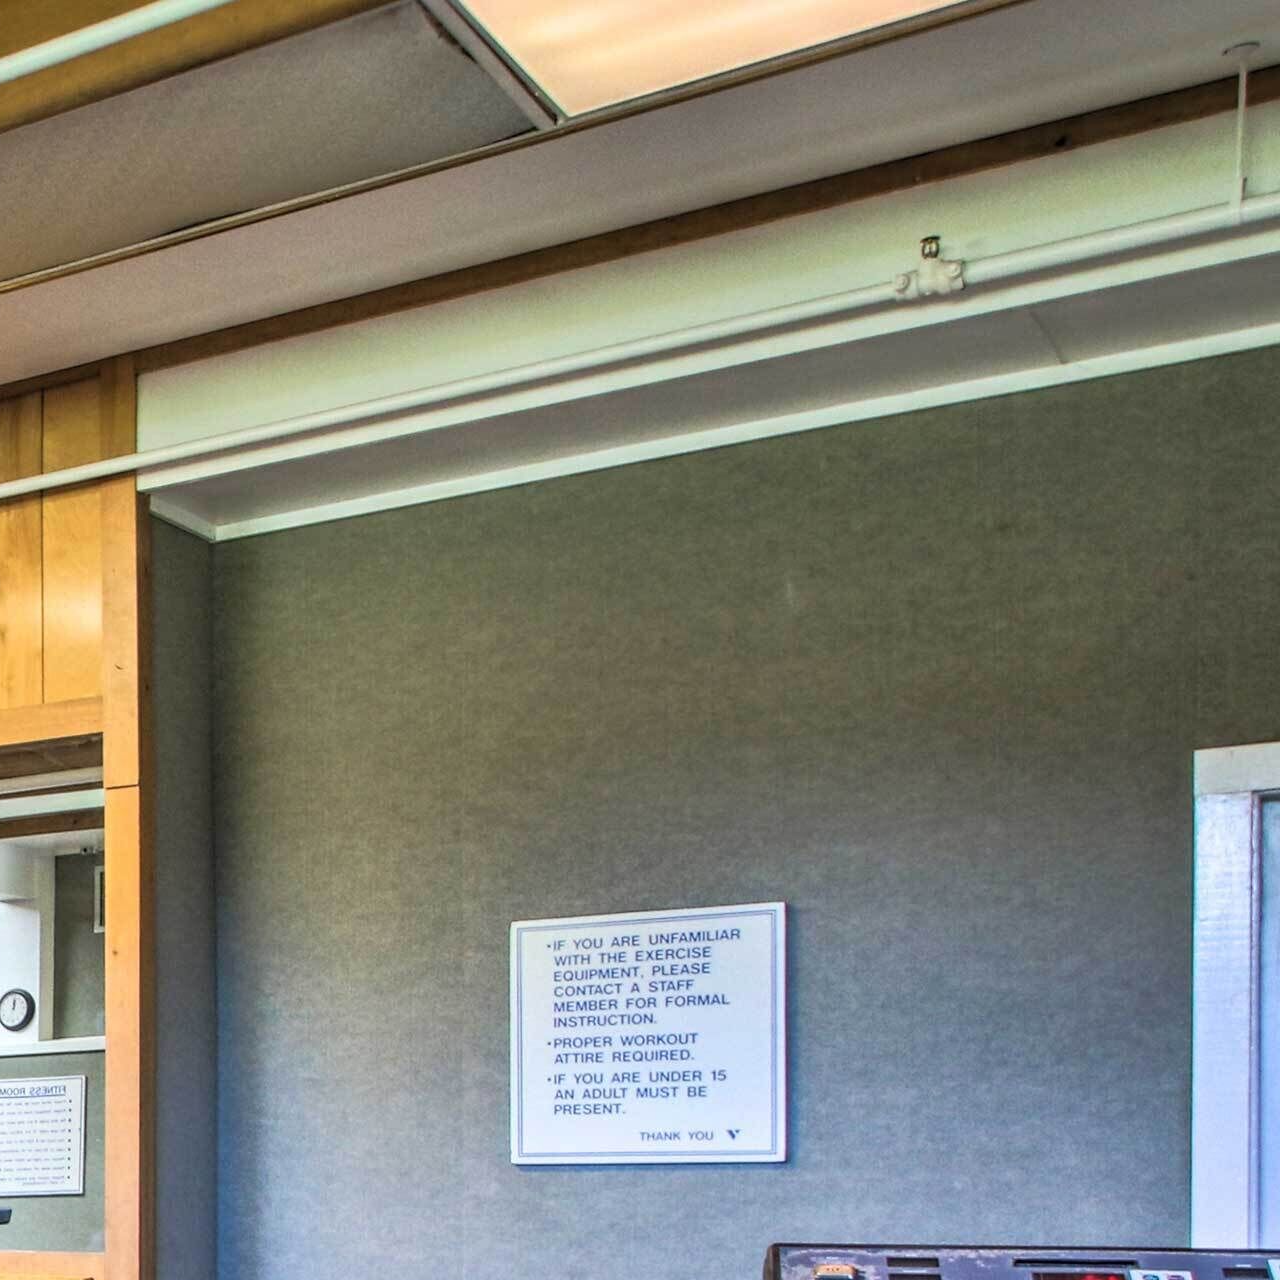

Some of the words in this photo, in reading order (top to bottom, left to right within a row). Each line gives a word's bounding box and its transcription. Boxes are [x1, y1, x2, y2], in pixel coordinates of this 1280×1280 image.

[553, 939, 567, 951] IF
[573, 938, 603, 950] YOU
[610, 935, 640, 947] ARE
[648, 928, 741, 945] UNFAMILIAR
[554, 954, 591, 967] WITH
[599, 952, 627, 963] THE
[635, 947, 712, 962] EXERCISE
[553, 967, 644, 982] EQUIPMENT,
[651, 963, 711, 977] PLEASE
[553, 983, 622, 997] CONTACT
[630, 982, 640, 993] A
[648, 979, 695, 992] STAFF
[553, 1000, 619, 1013] MEMBER
[626, 998, 657, 1009] FOR
[665, 994, 730, 1008] FORMAL
[553, 1013, 657, 1028] INSTRUCTION.
[553, 1036, 613, 1049] PROPER
[619, 1033, 699, 1047] WORKOUT
[554, 1052, 604, 1064] ATTIRE
[612, 1050, 695, 1063] REQUIRED.
[553, 1074, 567, 1084] IF
[573, 1073, 604, 1084] YOU
[611, 1072, 641, 1083] ARE
[649, 1071, 702, 1083] UNDER
[711, 1069, 727, 1081] 15
[554, 1089, 575, 1100] AN
[582, 1087, 628, 1099] ADULT
[635, 1086, 678, 1098] MUST
[687, 1086, 708, 1097] BE
[553, 1103, 626, 1116] PRESENT.
[640, 1131, 681, 1141] THANK
[688, 1131, 714, 1141] YOU
